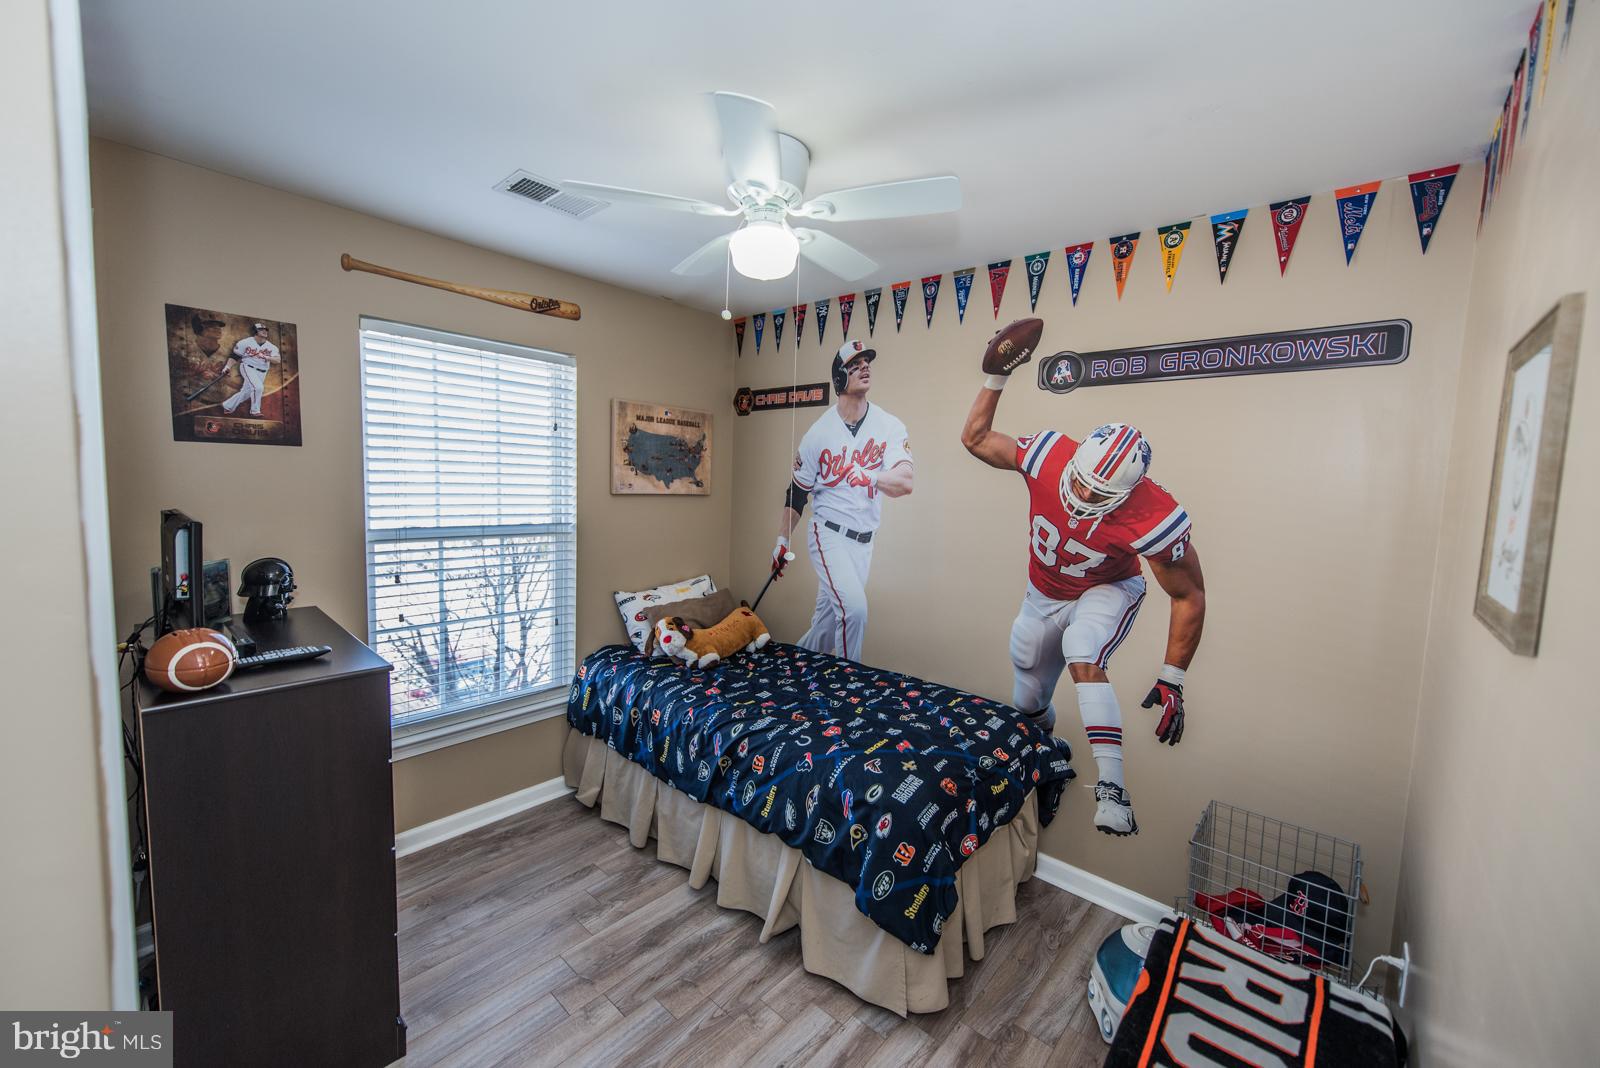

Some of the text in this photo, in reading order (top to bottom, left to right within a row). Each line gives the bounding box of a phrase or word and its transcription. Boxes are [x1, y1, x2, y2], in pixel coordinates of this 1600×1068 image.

[1343, 201, 1363, 236] Mets
[1091, 332, 1388, 378] ROB GRONKOWSKI
[755, 388, 824, 406] CHRIS DAVIS
[636, 414, 655, 423] MAJOR
[1032, 515, 1108, 578] 87
[761, 784, 777, 818] Steelers
[891, 774, 917, 799] CLEVELAND
[898, 776, 924, 804] BROWNS
[919, 803, 940, 830] JAGUARS
[923, 841, 942, 873] CARDINA
[904, 884, 930, 920] Steelers
